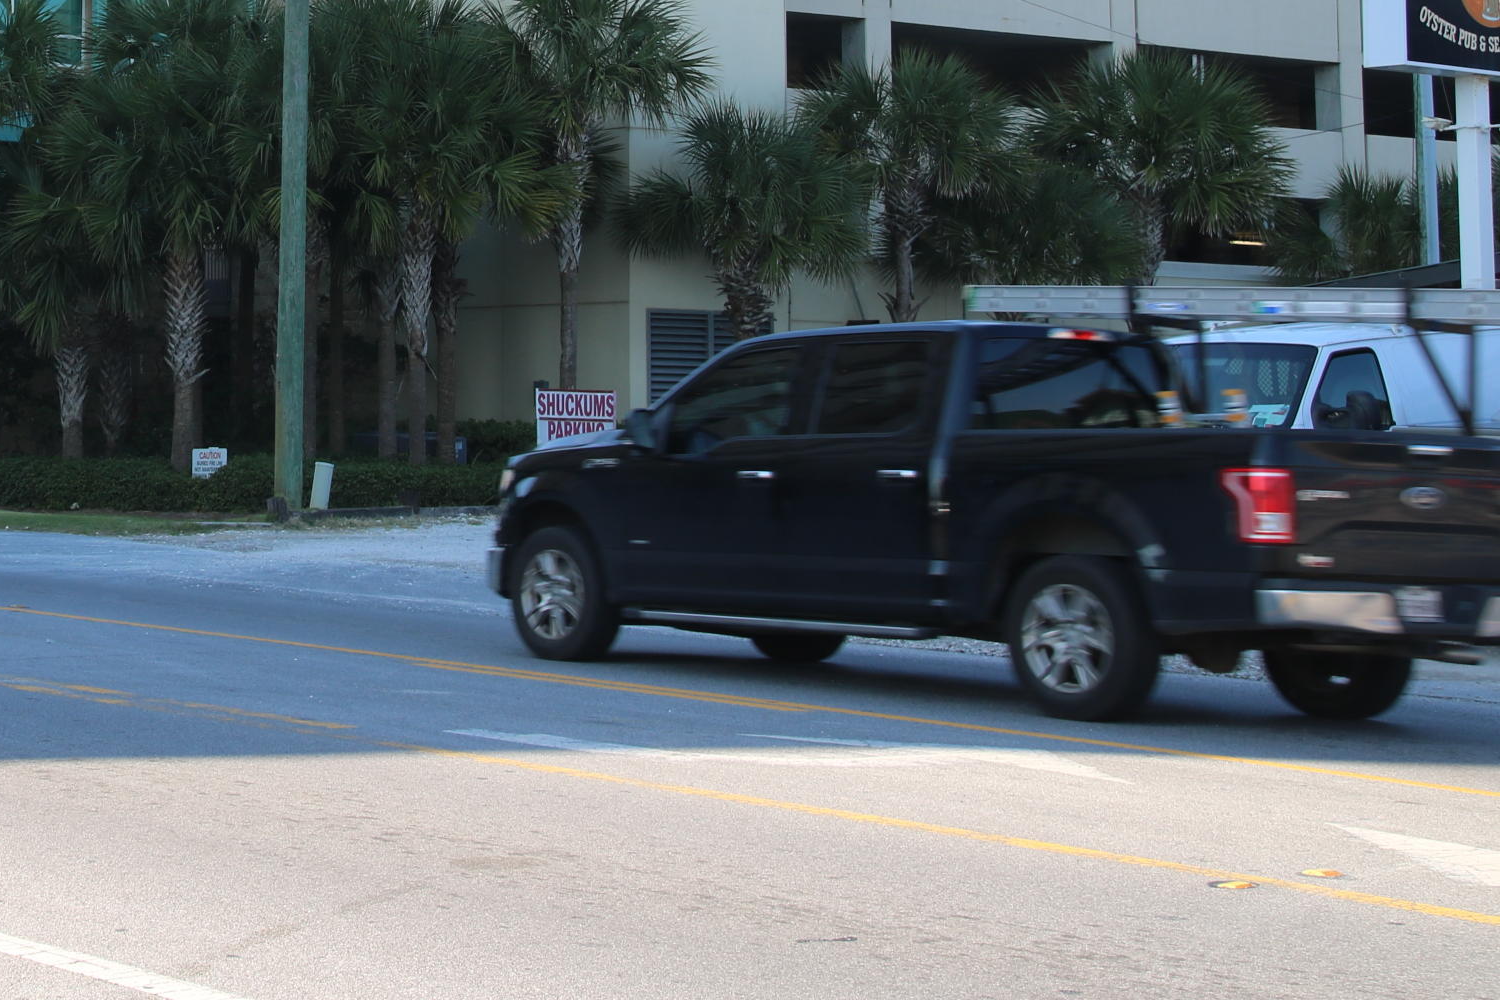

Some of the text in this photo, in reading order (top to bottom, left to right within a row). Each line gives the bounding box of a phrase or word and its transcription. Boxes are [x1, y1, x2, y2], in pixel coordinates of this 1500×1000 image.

[1420, 6, 1500, 53] OYSTER PUB & SE
[538, 392, 615, 418] SHUCKUMS
[199, 451, 222, 460] CAUTION
